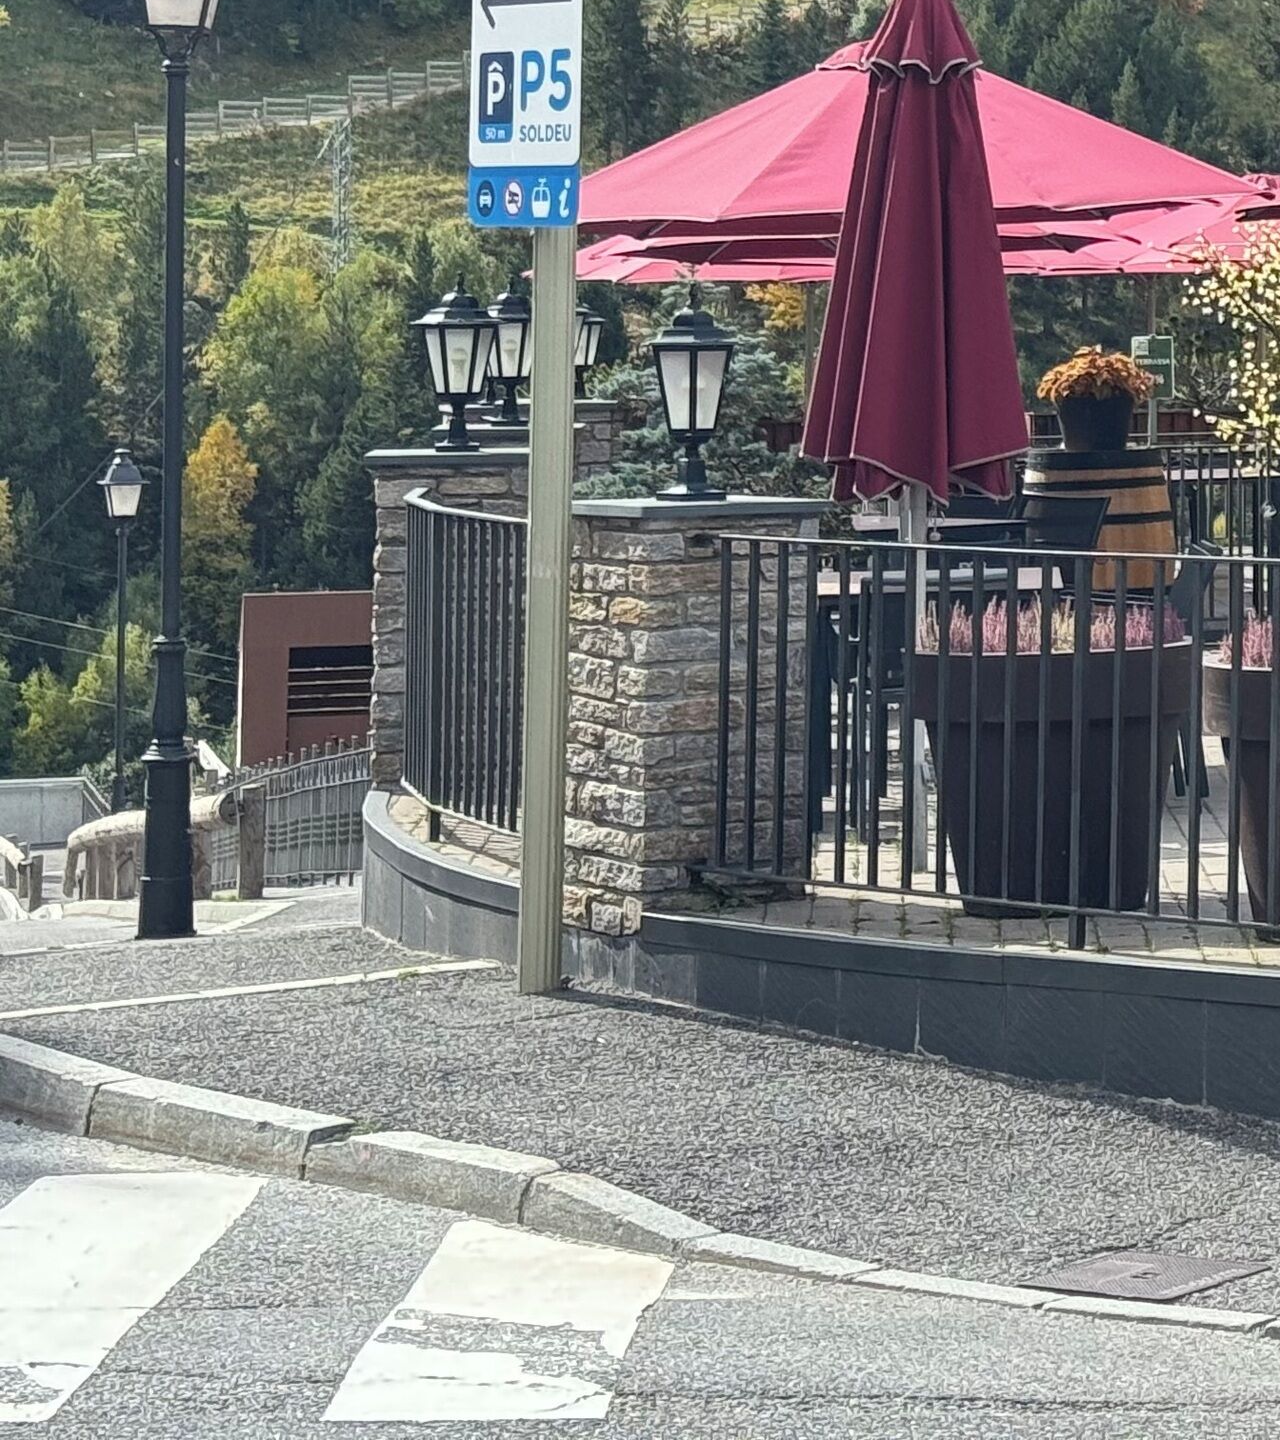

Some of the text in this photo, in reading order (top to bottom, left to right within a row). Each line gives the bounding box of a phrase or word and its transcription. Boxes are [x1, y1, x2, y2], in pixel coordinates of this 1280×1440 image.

[519, 48, 572, 112] P5
[498, 128, 506, 139] m
[519, 124, 572, 142] SOLDEU
